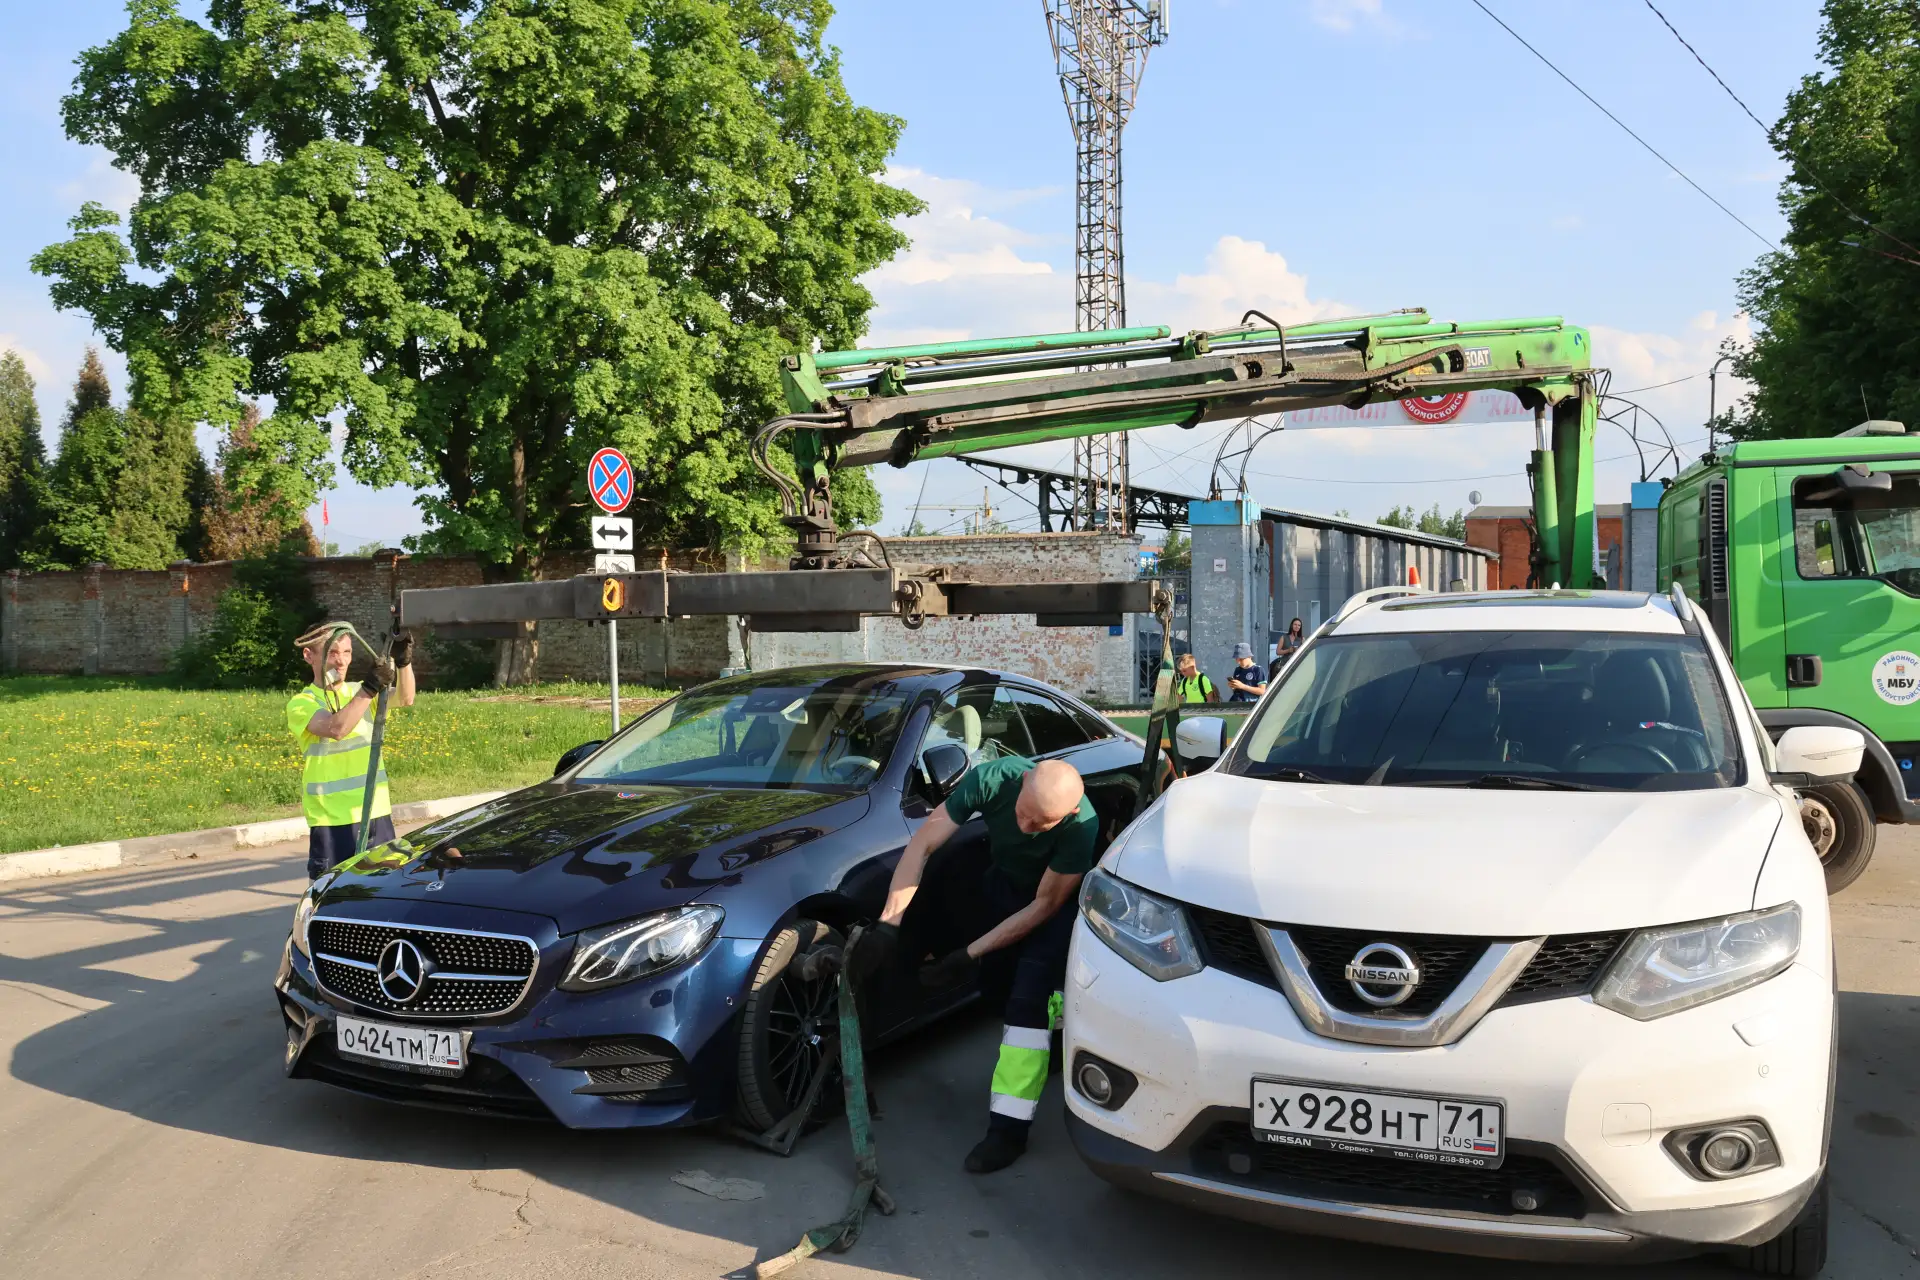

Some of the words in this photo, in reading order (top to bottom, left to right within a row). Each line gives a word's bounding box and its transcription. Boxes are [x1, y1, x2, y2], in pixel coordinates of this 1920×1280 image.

[1404, 392, 1464, 420] ОВОМОСКОВСК
[1882, 655, 1919, 667] РАЙОННОЕ
[1887, 678, 1915, 689] МБУ
[1351, 968, 1410, 982] NISSAN
[429, 1055, 446, 1064] RUS
[1444, 1105, 1483, 1137] 71
[1267, 1133, 1312, 1147] NISSAN
[1442, 1135, 1472, 1149] RUS
[1338, 1143, 1375, 1154] Сервис+
[1393, 1150, 1414, 1158] тел.:
[1415, 1151, 1437, 1162] (495)
